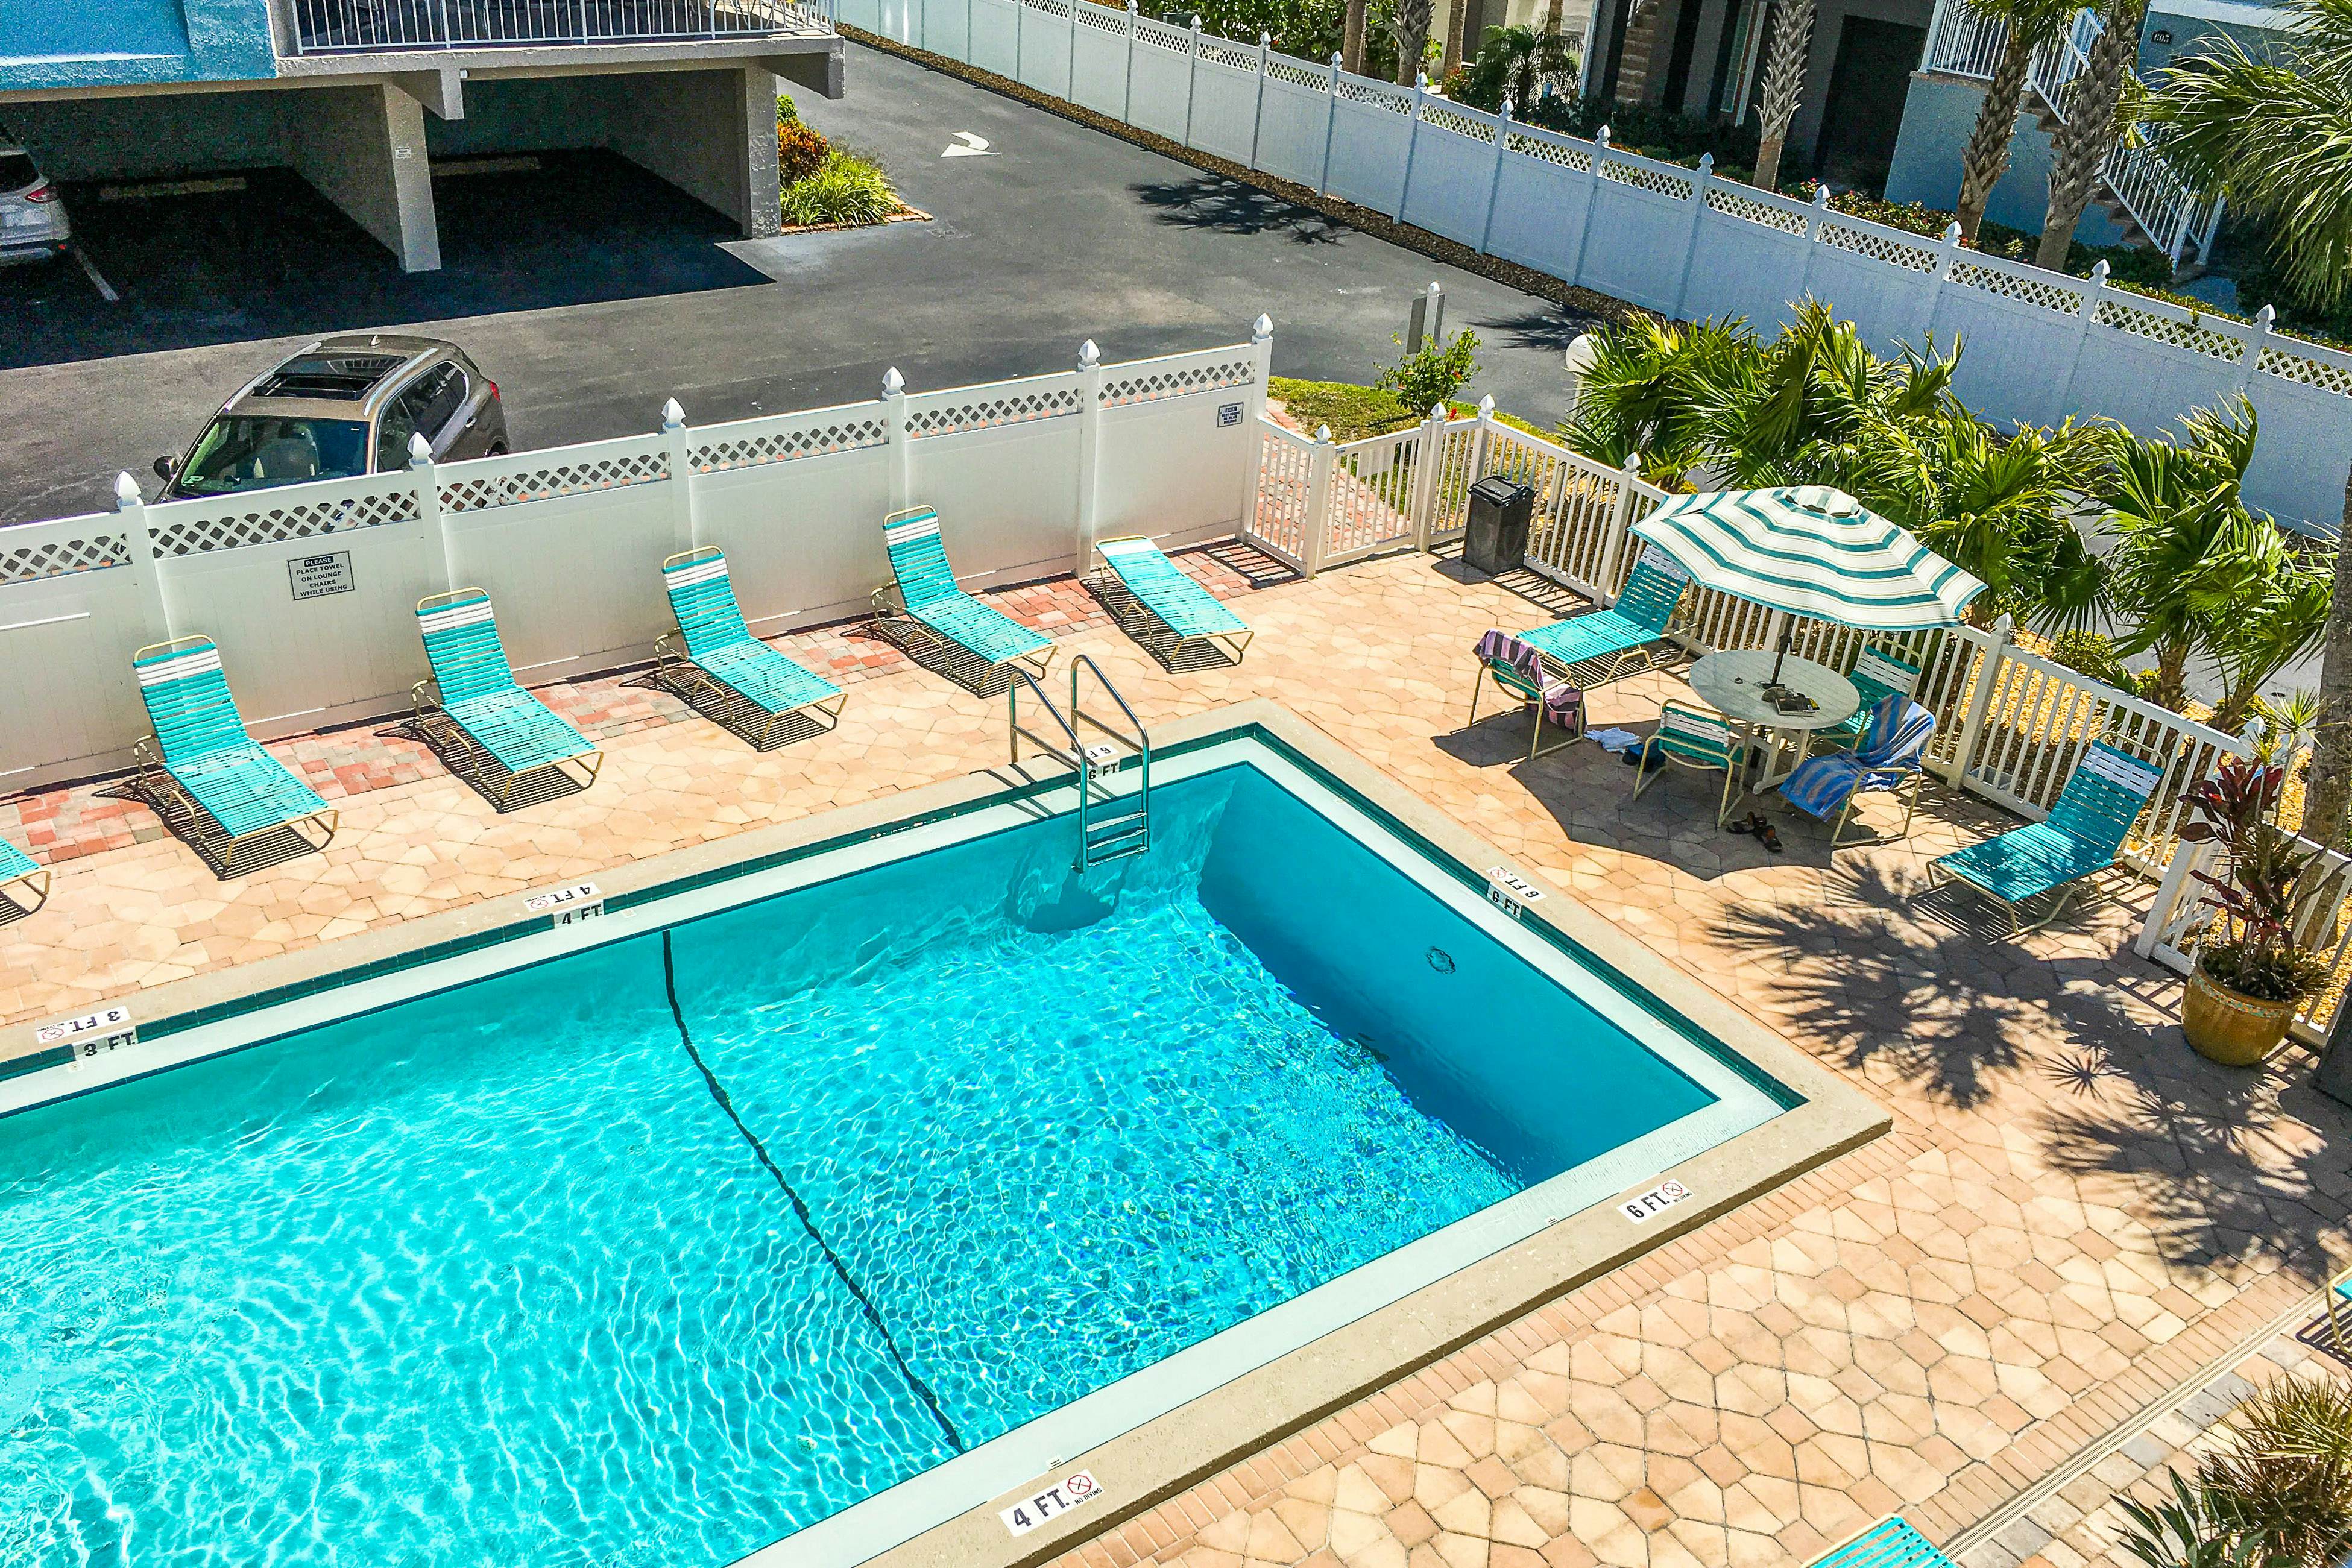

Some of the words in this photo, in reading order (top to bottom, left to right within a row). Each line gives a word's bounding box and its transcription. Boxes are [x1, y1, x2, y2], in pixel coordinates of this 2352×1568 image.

[306, 557, 332, 566] PLEASE
[314, 571, 342, 579] LOUNGE
[309, 579, 336, 588] CHAIRS
[300, 588, 324, 597] WHILE
[326, 584, 347, 593] USING
[1089, 769, 1096, 779] 6
[1492, 890, 1499, 903] 6
[562, 912, 572, 924] 4
[107, 1011, 121, 1021] 3
[84, 1043, 98, 1056] 3
[108, 1032, 136, 1050] FT.
[1627, 1204, 1645, 1218] 6
[1641, 1192, 1670, 1211] FT.
[1084, 1487, 1102, 1500] DIVING
[1014, 1508, 1032, 1526] 4
[1033, 1488, 1070, 1517] FT.
